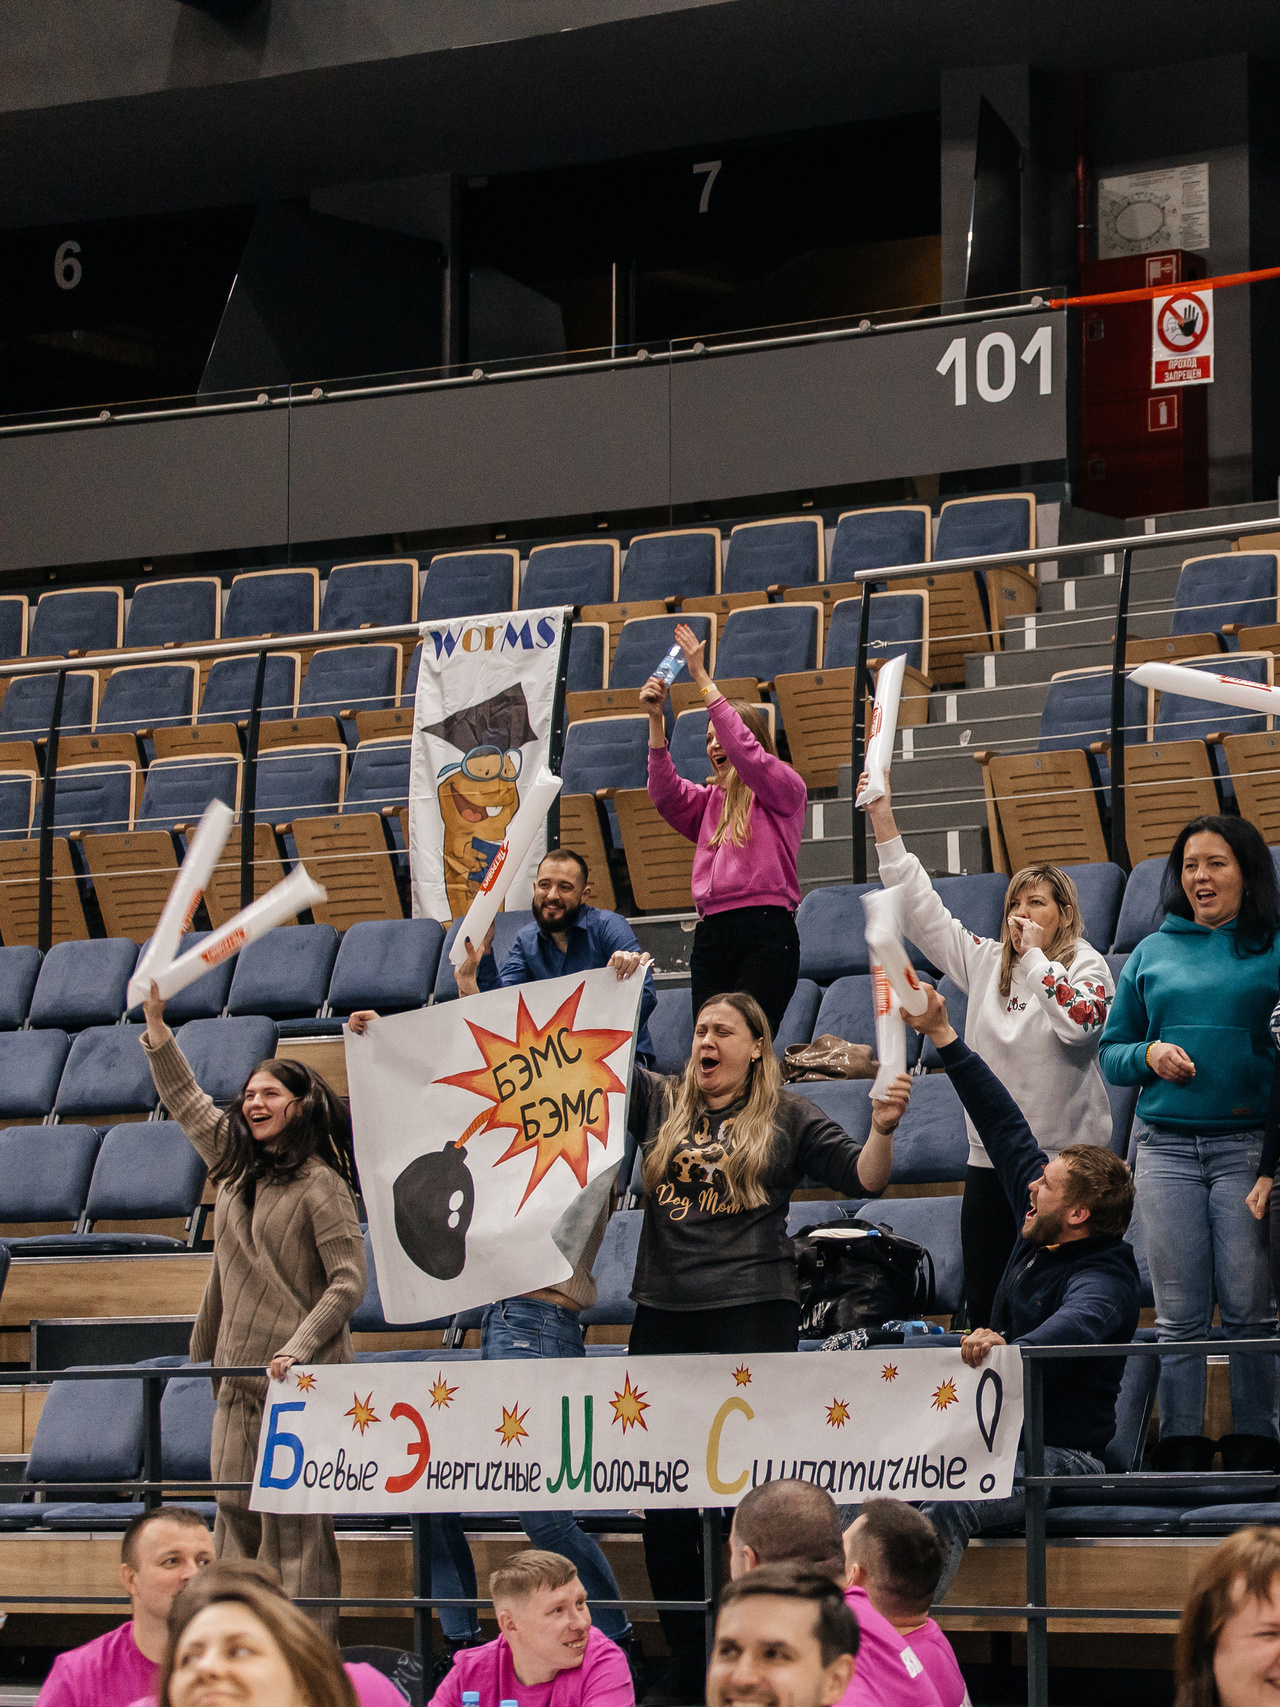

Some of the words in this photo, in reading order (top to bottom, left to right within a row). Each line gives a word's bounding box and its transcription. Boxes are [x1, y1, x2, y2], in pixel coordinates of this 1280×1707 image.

[693, 160, 722, 213] 7
[54, 240, 82, 290] 6
[936, 326, 1053, 406] 101
[1164, 368, 1202, 382] ЗАПРЕЩЕН
[1168, 357, 1198, 370] ПРОХОД
[492, 1027, 582, 1103] БЭМС
[520, 1088, 604, 1141] БЭМС
[656, 1183, 693, 1221] Dog
[699, 1187, 744, 1215] Mom
[259, 1401, 379, 1490] Боевые
[384, 1402, 541, 1493] Энергичные
[546, 1395, 690, 1493] Молодые
